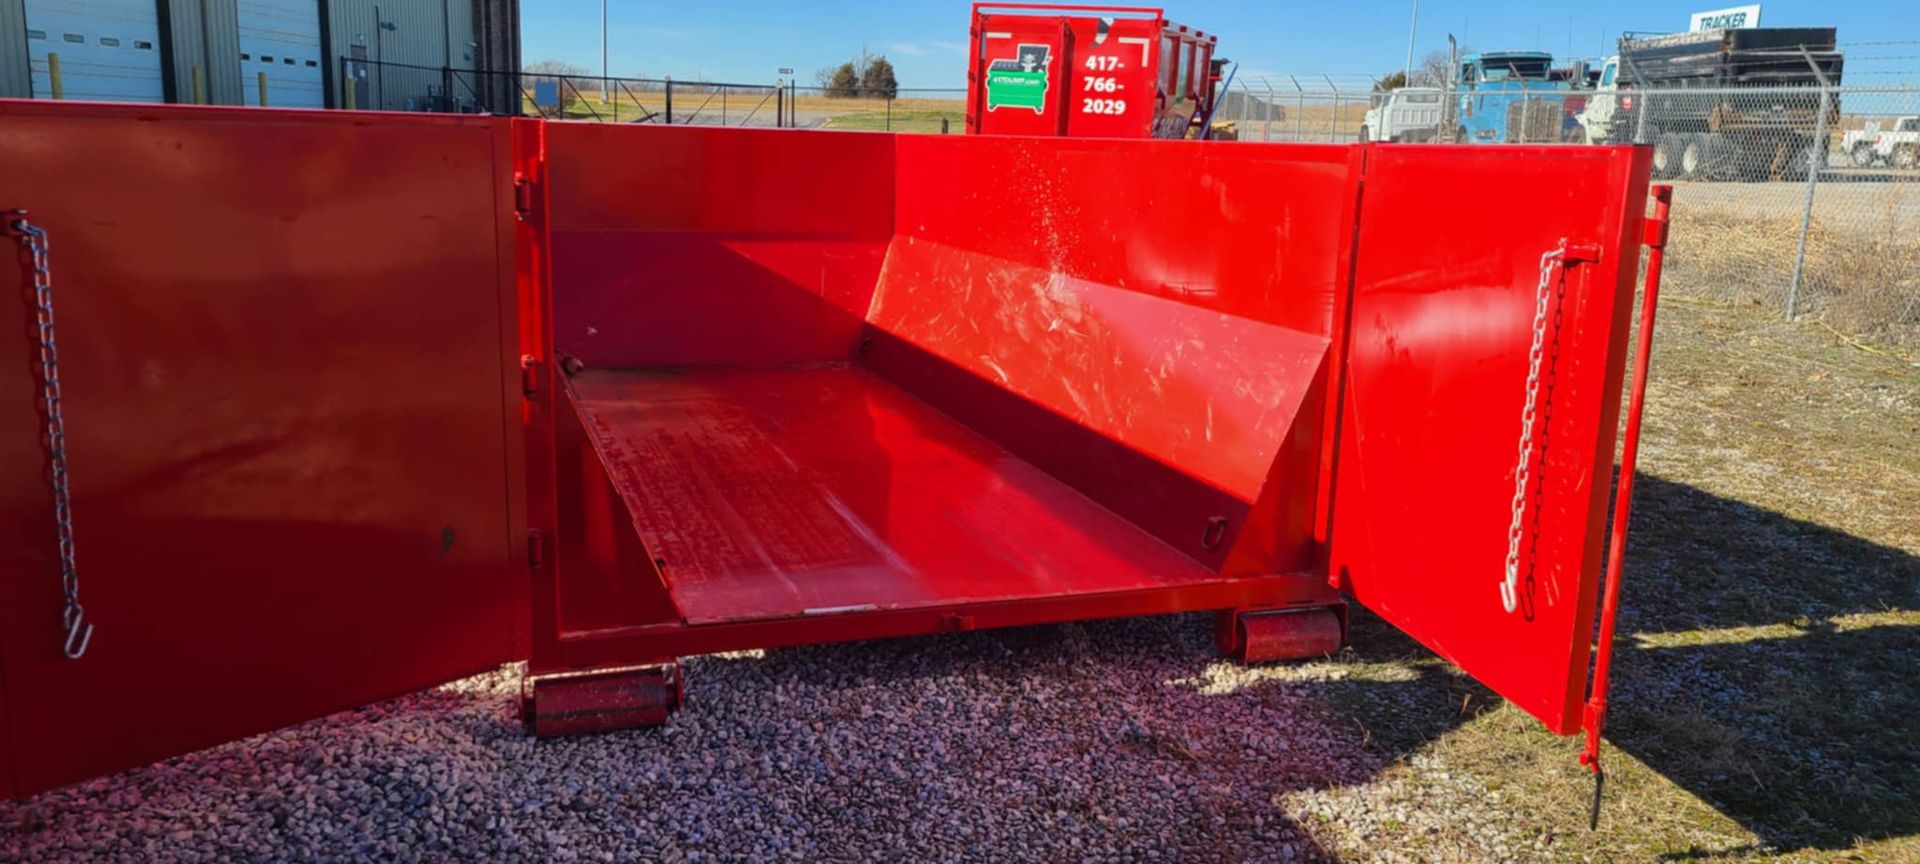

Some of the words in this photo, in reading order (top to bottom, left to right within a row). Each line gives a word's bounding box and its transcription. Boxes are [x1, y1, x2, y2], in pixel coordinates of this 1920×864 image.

[1700, 12, 1747, 31] TRACKER
[1085, 55, 1125, 71] 417-
[1083, 76, 1125, 93] 766-
[1082, 98, 1126, 115] 2029
